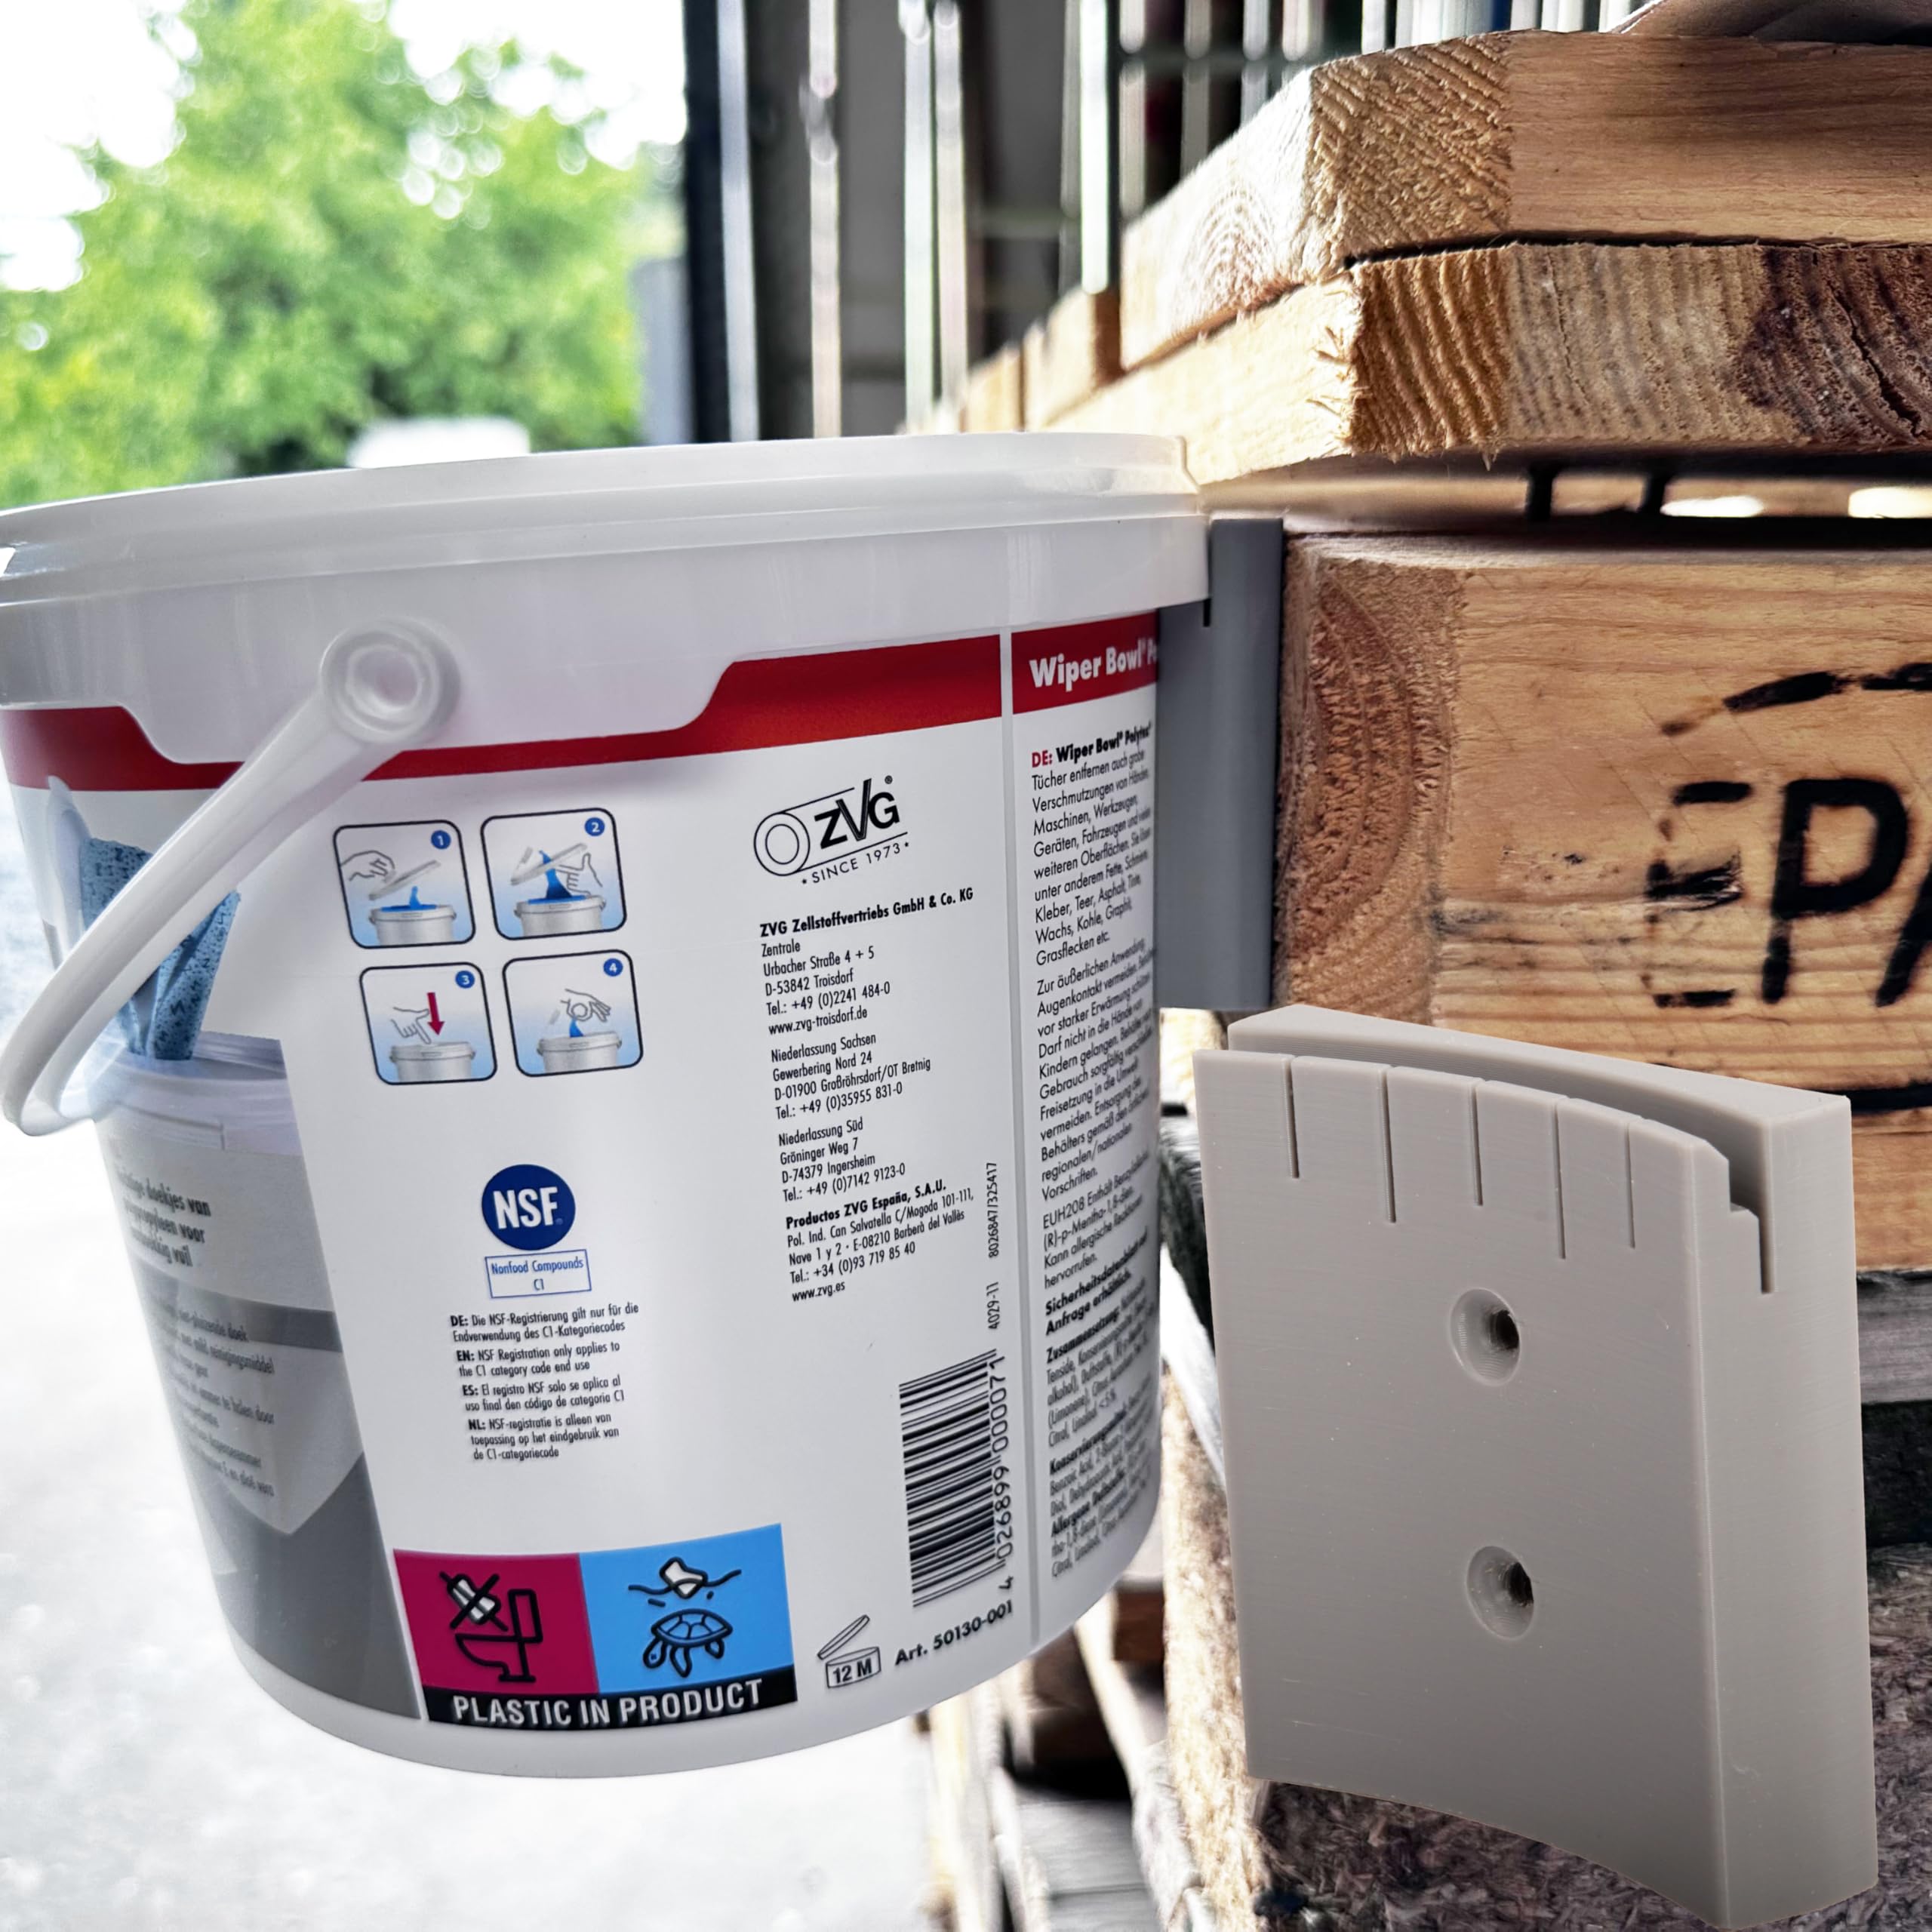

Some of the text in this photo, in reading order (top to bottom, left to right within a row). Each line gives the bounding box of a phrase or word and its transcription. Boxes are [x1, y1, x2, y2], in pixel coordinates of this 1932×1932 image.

[1029, 654, 1101, 691] Wiper
[1032, 751, 1052, 768] DE:
[1056, 743, 1093, 764] Wiper
[1032, 771, 1066, 792] Tücher
[1069, 761, 1109, 783] entfernen
[1032, 783, 1114, 813] Verschmutzungen
[1034, 811, 1091, 836] Maschinen,
[1034, 837, 1079, 857] Geräten,
[812, 843, 900, 884] SINCE 1973
[1035, 857, 1078, 879] weiteren
[1035, 882, 1061, 902] unter
[1064, 869, 1103, 892] anderem
[760, 888, 973, 937] ZVG Zellstoffvertriebs GmbH Co. KG
[1035, 894, 1095, 923] Kleber, Teer,
[1035, 911, 1103, 944] Wachs, Kohle,
[761, 938, 801, 957] Zentrale
[764, 946, 874, 977] Urbacher Straße 4 5
[1036, 937, 1094, 966] Grasflecken
[765, 968, 854, 996] D-53842 Troisdorf
[1037, 980, 1054, 996] Zur
[767, 982, 890, 1016] Tel.: +49 (0)2241 484-0
[1037, 980, 1102, 1018] Augenkontakt
[768, 1005, 867, 1035] www.zvg-troisdorf.de
[1038, 1008, 1089, 1037] vor starker
[771, 1032, 876, 1063] Niederlassung Sachsen
[1038, 1027, 1086, 1058] Darf nicht
[774, 1051, 872, 1081] Gewerbering Nord 24
[775, 1081, 817, 1100] D-01900
[902, 1058, 931, 1074] Bretnig
[1039, 1055, 1078, 1080] Kindern
[1039, 1069, 1088, 1099] Gebrauch
[776, 1081, 903, 1119] Tel.: +49 (0)35955 831-0
[1040, 1089, 1093, 1121] Freisetzung
[779, 1117, 863, 1146] Niederlassung Süd
[1041, 1109, 1092, 1140] vermeiden.
[780, 1137, 857, 1164] Gröninger Weg 7
[1041, 1131, 1084, 1161] Behälters
[782, 1154, 875, 1183] D-74379 Ingersheim
[783, 1163, 906, 1202] Tel.: +49 (0)7142 9123-0
[493, 1185, 558, 1229] NSF
[786, 1180, 946, 1229] Productos ZVG España, S.A.U.
[1043, 1196, 1084, 1229] EUH208
[788, 1234, 804, 1247] Pol.
[808, 1228, 826, 1242] Ind.
[830, 1225, 847, 1238] Can
[851, 1214, 891, 1234] Salvatella
[895, 1200, 938, 1225] C/Mogoda
[789, 1251, 812, 1266] Nave
[817, 1247, 820, 1260] 1
[836, 1243, 841, 1255] 2
[854, 1230, 890, 1251] E-08210
[928, 1217, 940, 1230] del
[491, 1257, 583, 1275] Nonfood Compounds
[790, 1241, 915, 1284] Tel.: +34 (0)93 719 85 40
[1044, 1249, 1069, 1269] Kann
[534, 1278, 544, 1291] C1
[792, 1281, 845, 1302] www.zvg.es
[451, 1315, 468, 1327] DE:
[472, 1313, 486, 1326] Die
[489, 1309, 568, 1327] NSF-Registrierung
[572, 1306, 586, 1321] gilt
[591, 1307, 605, 1318] nur
[625, 1302, 638, 1314] die
[986, 1282, 999, 1330] 4029-11
[1046, 1302, 1090, 1336] Anfrage
[453, 1321, 625, 1343] Endverwendung des C1-Kategoriecodes
[457, 1341, 620, 1361] EN: NSF Registration only applies to
[459, 1360, 589, 1380] the C1 category code end use
[463, 1377, 608, 1398] ES: registro NSF solo aplica
[465, 1389, 624, 1411] uso final den código de C1
[469, 1414, 611, 1432] NL: NSF-registratie alleen van
[471, 1427, 619, 1448] toepassing het eindgebruik van
[474, 1445, 558, 1461] de C1-categoriecode
[988, 1355, 1013, 1589] 4 026899 000071
[895, 1600, 1012, 1666] Art. 50130-001
[832, 1659, 872, 1684] 12 M
[453, 1679, 762, 1725] PLASTIC IN PRODUCT
